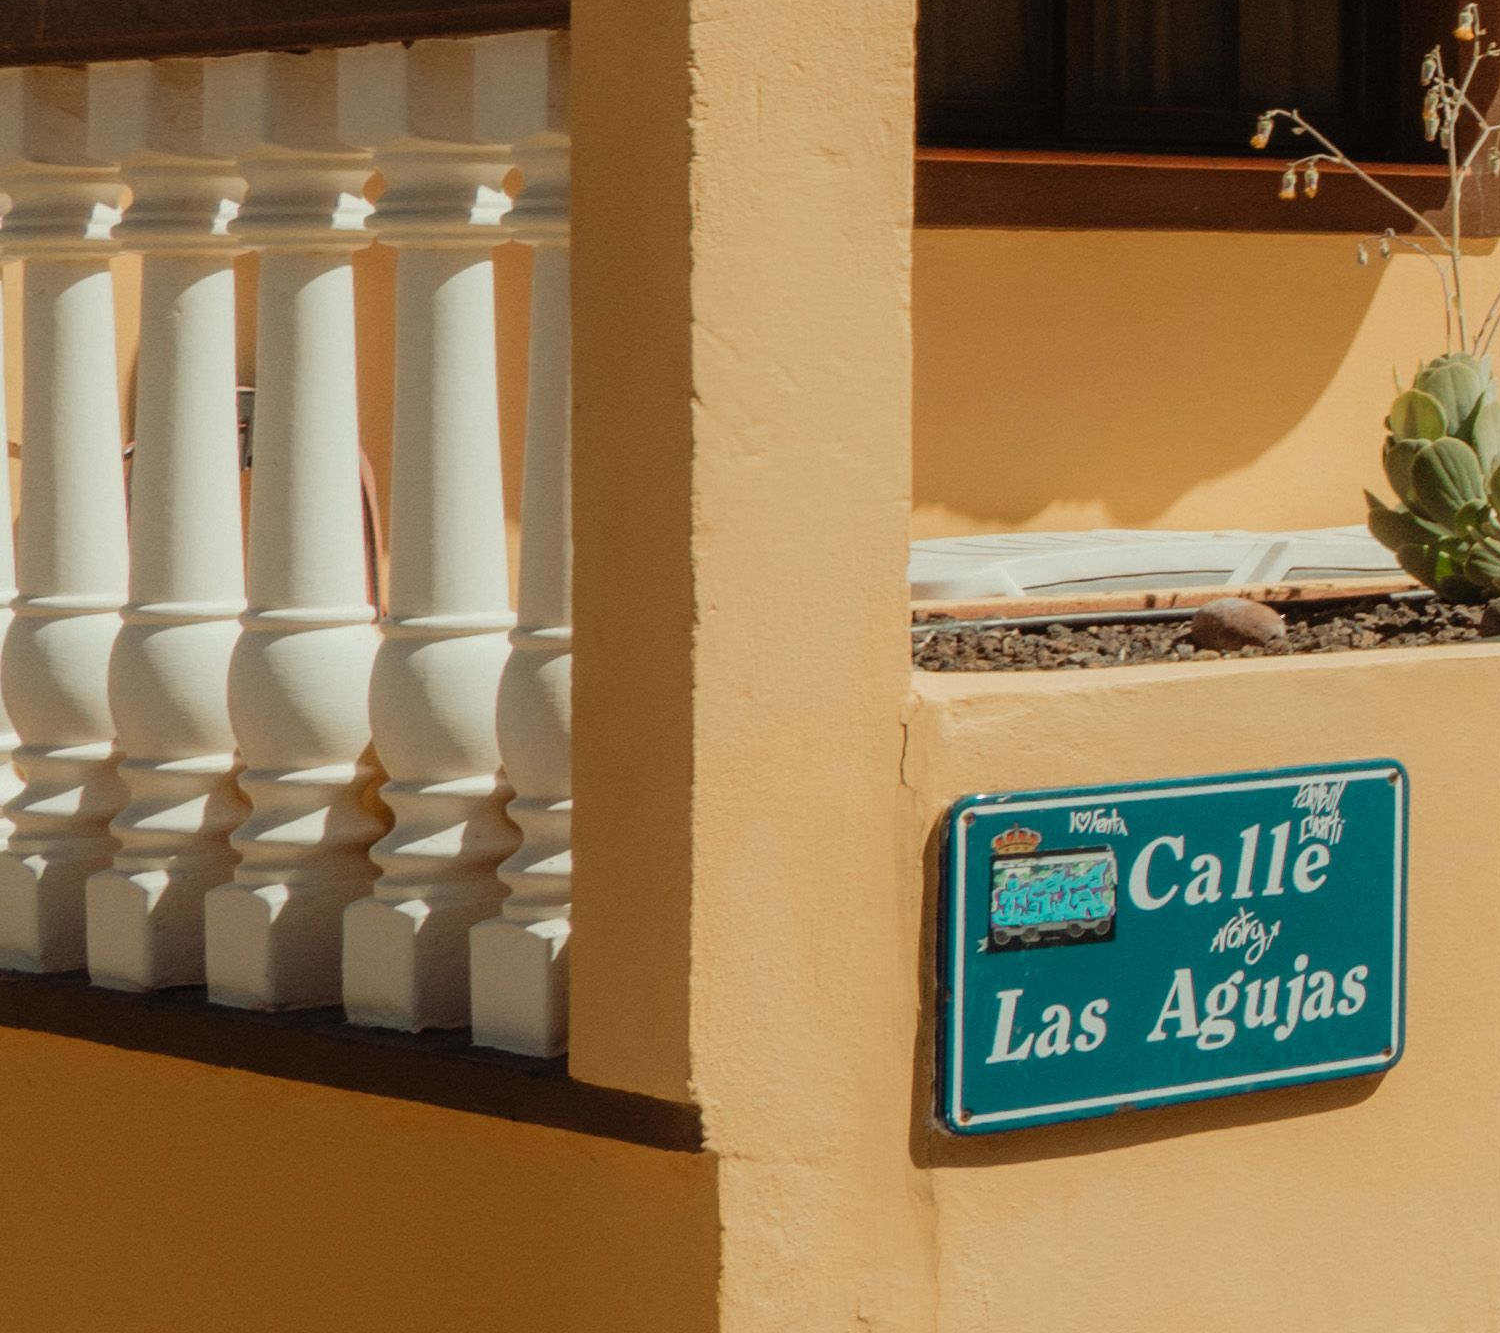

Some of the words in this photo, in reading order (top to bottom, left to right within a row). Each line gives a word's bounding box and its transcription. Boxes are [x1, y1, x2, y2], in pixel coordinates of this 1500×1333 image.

[1128, 824, 1331, 910] Calle
[985, 989, 1110, 1065] Las
[1147, 953, 1369, 1051] Agujas
